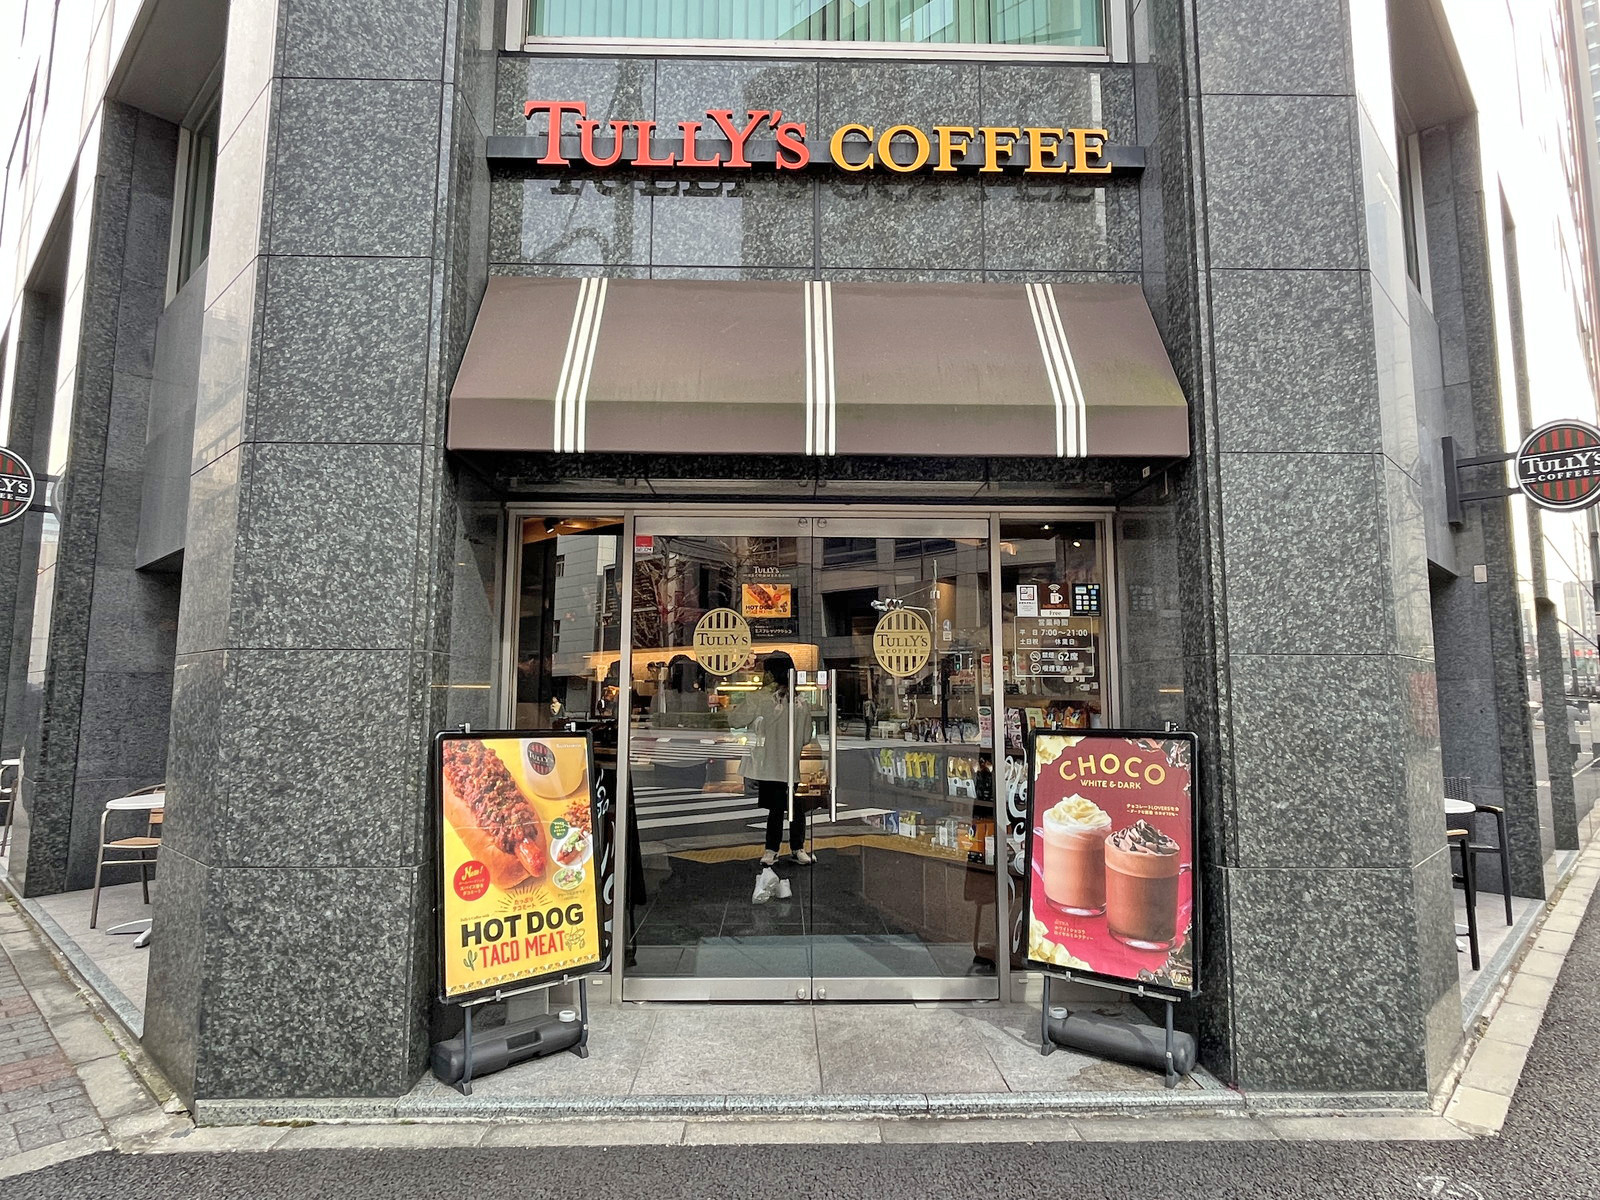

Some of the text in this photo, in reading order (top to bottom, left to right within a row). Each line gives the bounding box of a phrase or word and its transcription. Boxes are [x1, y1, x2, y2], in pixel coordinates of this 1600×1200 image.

[524, 100, 1113, 175] TULLY'S COFFEE
[1537, 469, 1591, 482] COFFEE
[753, 566, 780, 574] TULLY'S
[1038, 619, 1069, 627] 営業時間
[876, 634, 928, 648] TULLY'S
[1055, 638, 1075, 646] 休業日
[1059, 753, 1166, 786] CHOCO
[1080, 779, 1142, 790] WHITE & DARK
[514, 896, 534, 905] たっぷり
[512, 903, 536, 912] タコミート
[461, 903, 584, 948] HOT DOG
[480, 930, 565, 968] TACO MEAT
